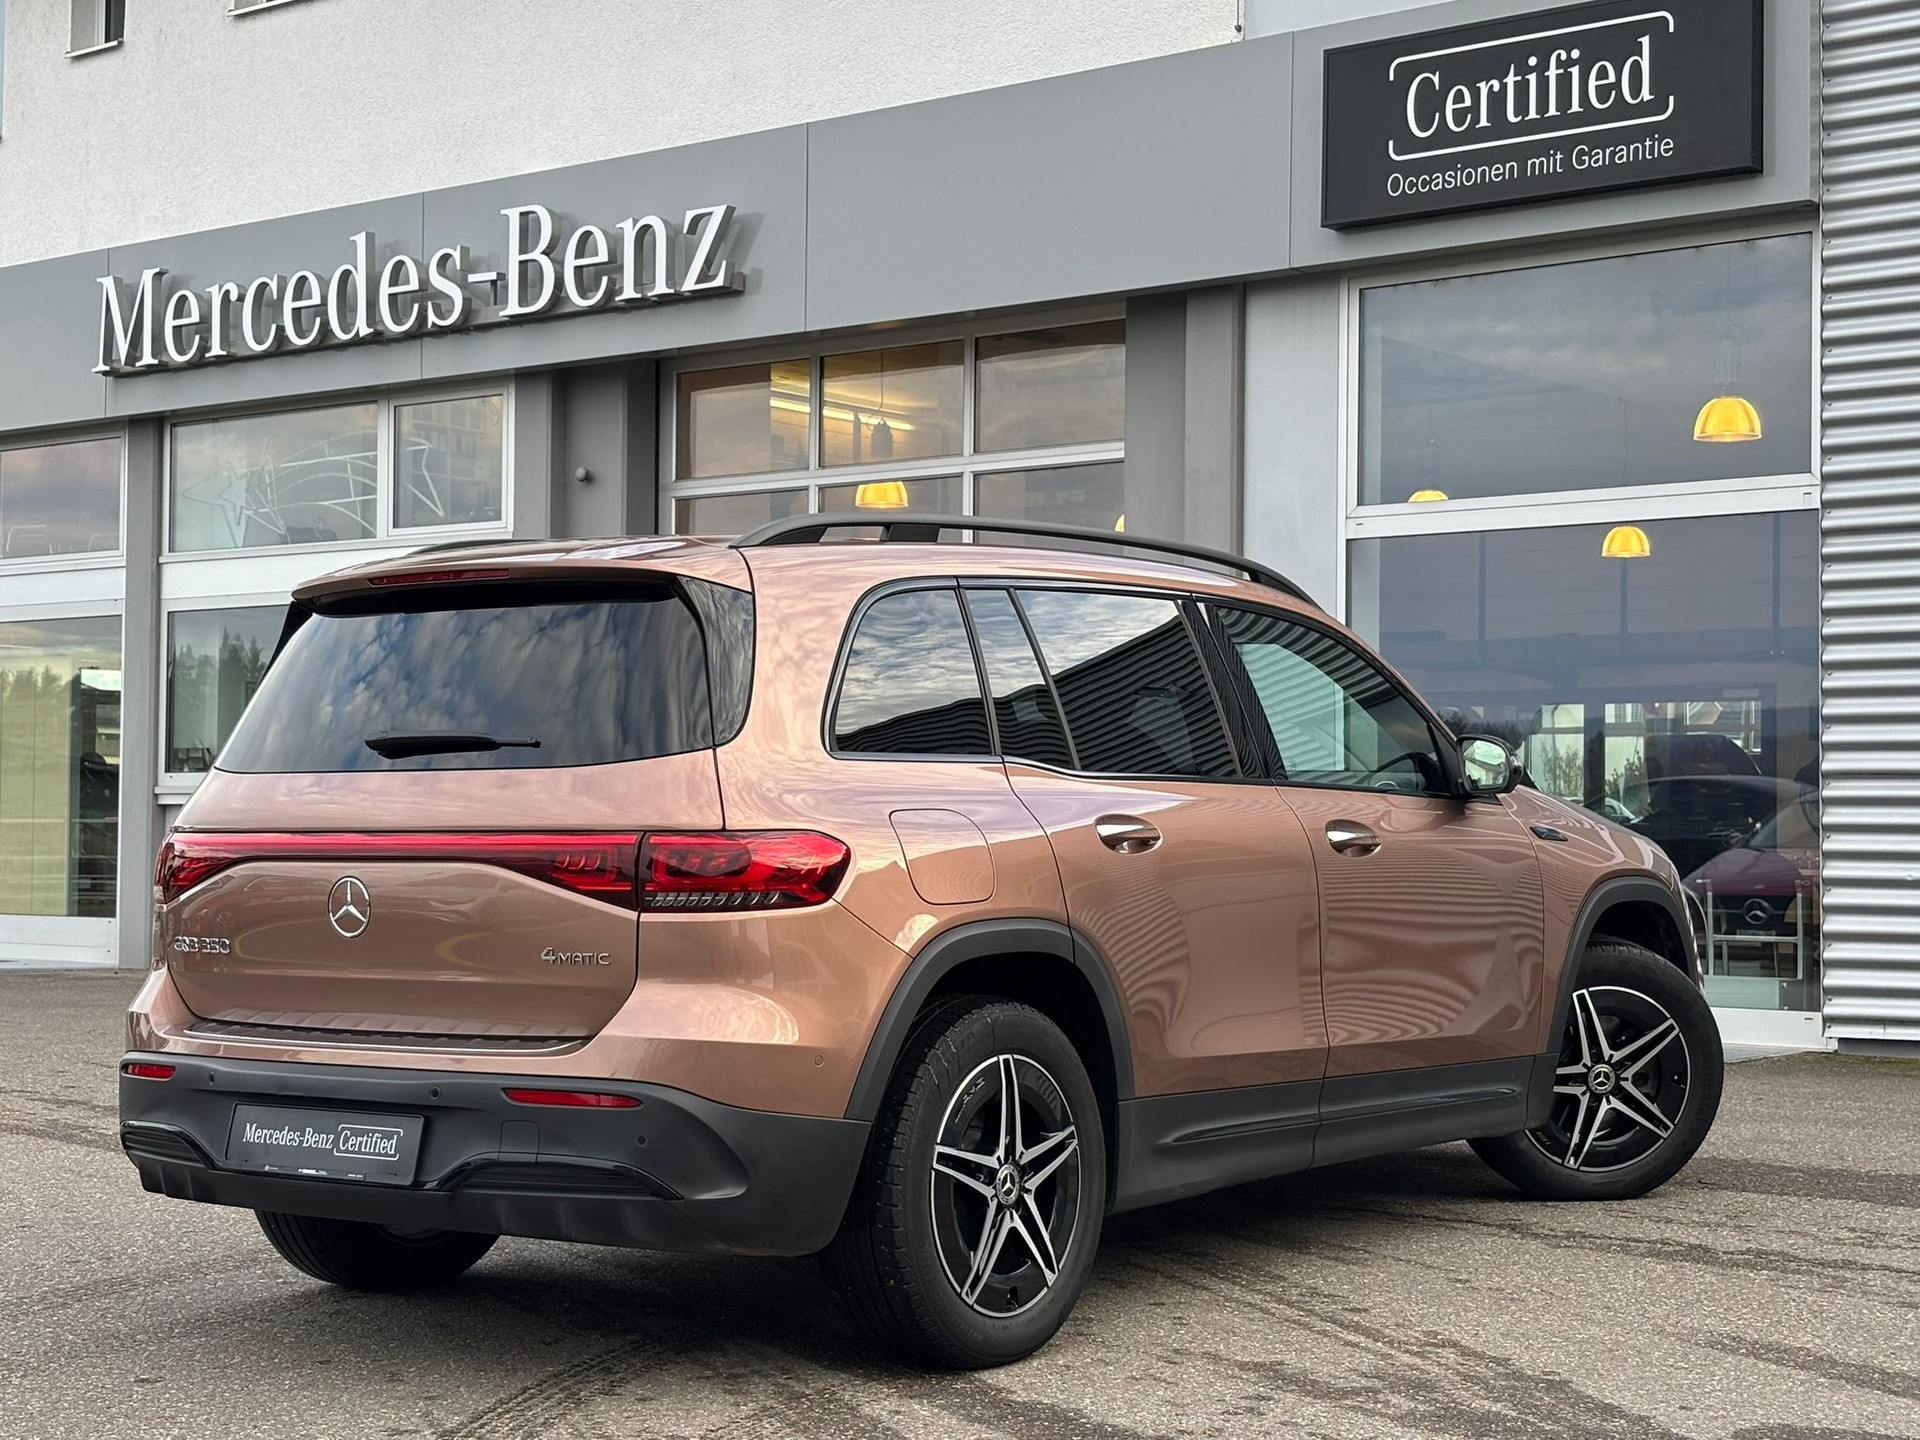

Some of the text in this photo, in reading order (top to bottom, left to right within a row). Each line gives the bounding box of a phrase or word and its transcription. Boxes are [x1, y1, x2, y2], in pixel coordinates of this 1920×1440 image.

[1405, 34, 1655, 139] Certified
[1386, 133, 1675, 198] Occasionen mit Garantie
[92, 203, 736, 376] Mercedes-Benz
[200, 937, 231, 954] 350
[540, 946, 610, 965] 4MATIC
[242, 1122, 398, 1155] Mercedes-Benz Certified
